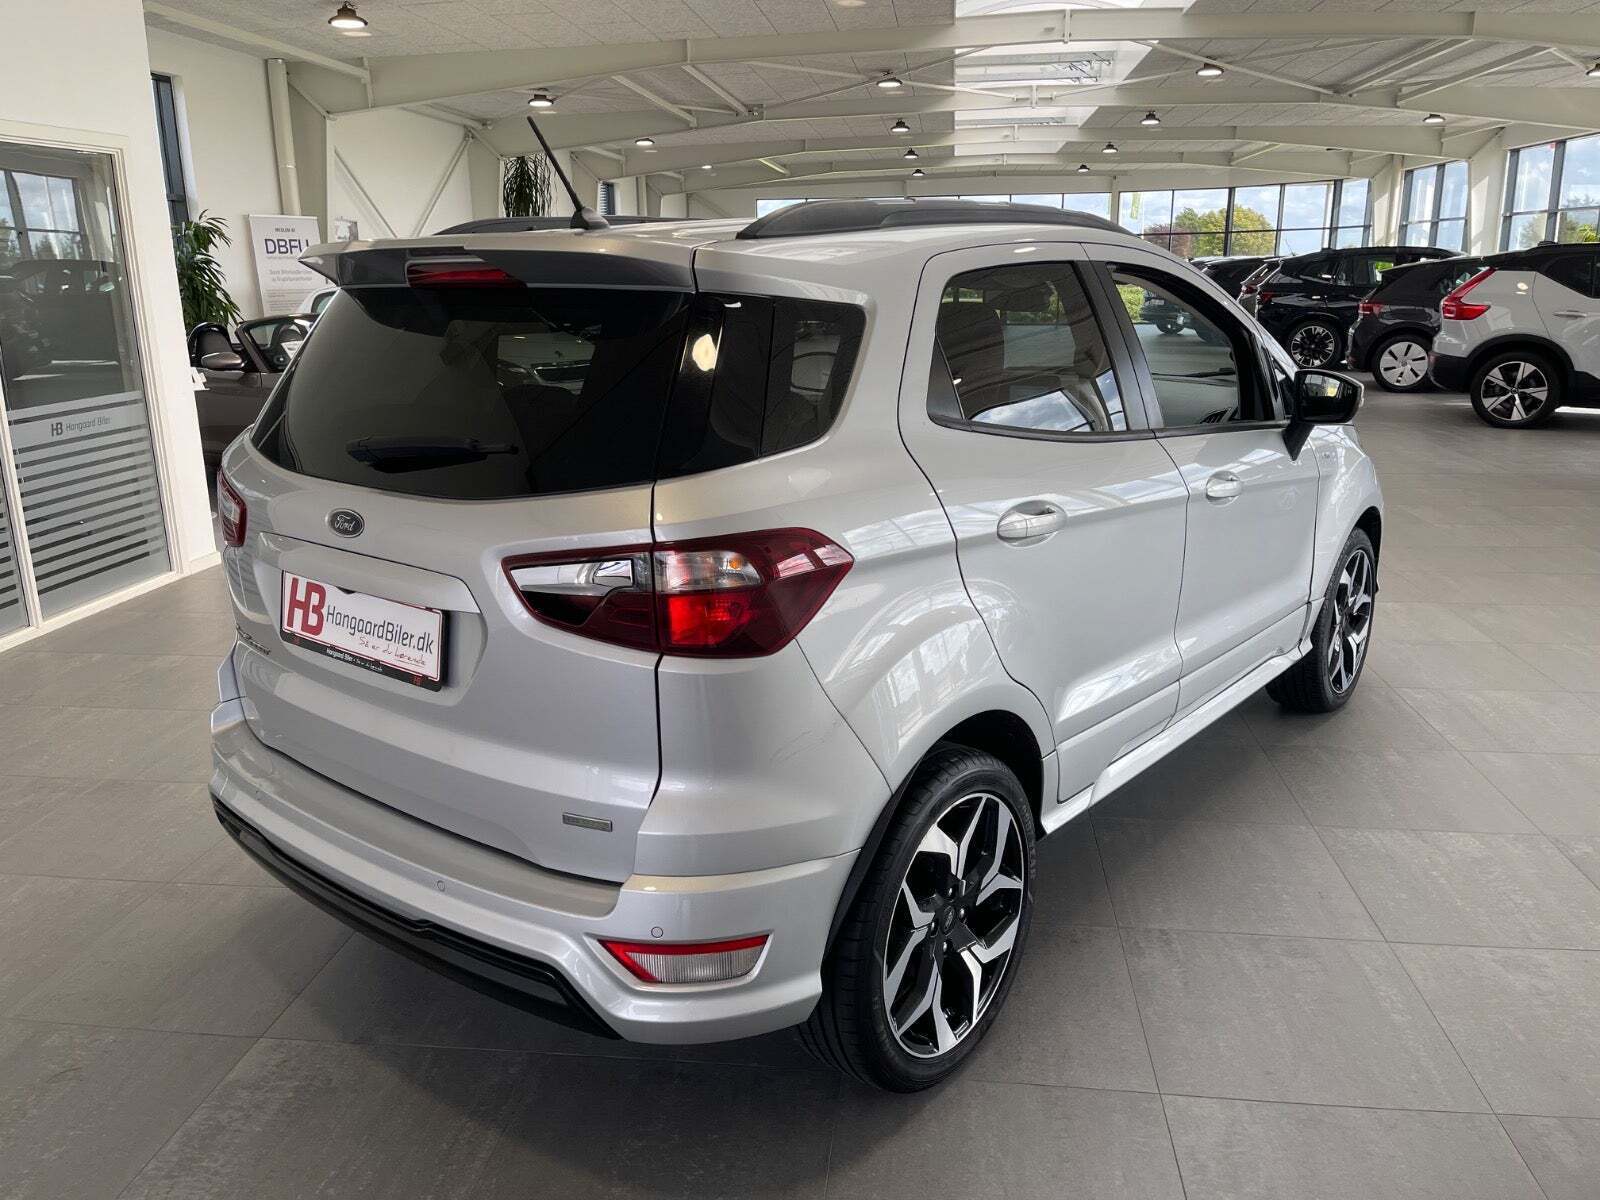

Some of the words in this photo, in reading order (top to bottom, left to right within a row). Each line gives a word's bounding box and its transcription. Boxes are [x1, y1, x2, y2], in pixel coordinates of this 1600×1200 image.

[51, 422, 63, 436] HB
[334, 513, 356, 532] Ford
[286, 576, 327, 637] HB
